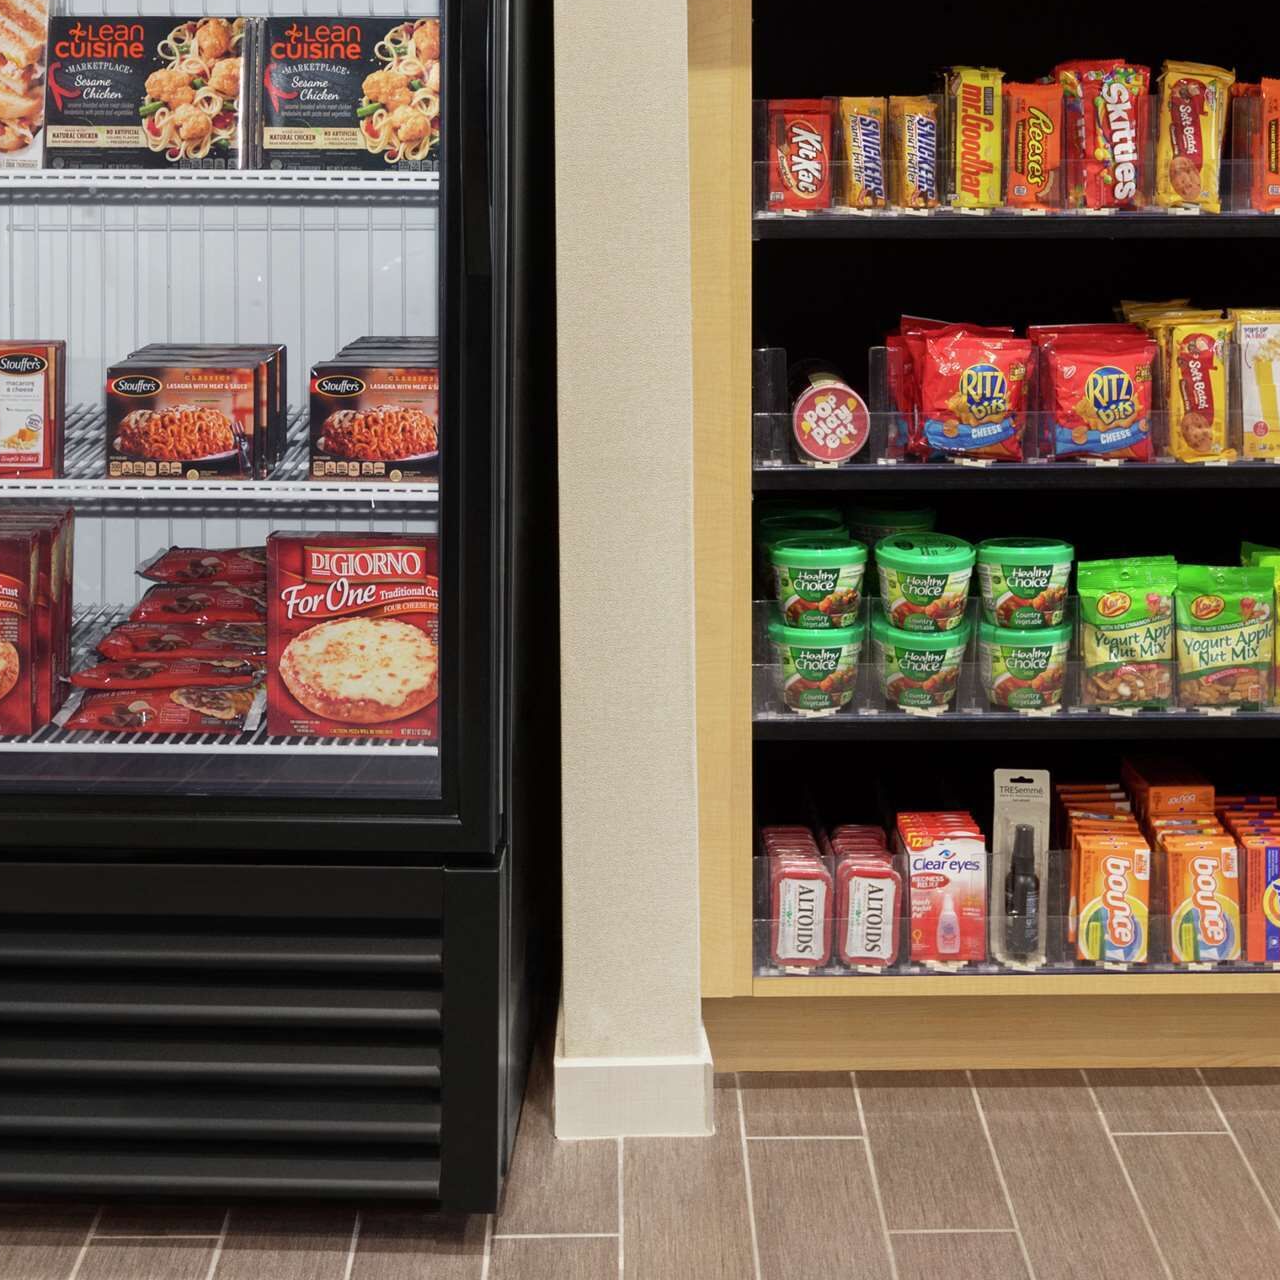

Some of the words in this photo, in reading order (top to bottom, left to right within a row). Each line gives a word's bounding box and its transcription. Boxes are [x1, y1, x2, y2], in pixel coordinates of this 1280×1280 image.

[88, 24, 144, 41] Lean
[304, 25, 360, 42] Lean
[69, 62, 130, 73] MARKETPLACE
[284, 63, 347, 74] MARKETPLACE
[74, 75, 111, 86] Sesame
[292, 76, 329, 87] Sesame
[83, 88, 122, 99] Chicken
[300, 89, 339, 101] Chicken
[1028, 107, 1054, 186] Reese's
[1103, 83, 1137, 200] Skittles
[859, 117, 886, 200] SNICKERS
[917, 114, 936, 199] SNICKERS
[0, 358, 40, 371] Stouffer's
[118, 380, 155, 392] Stouffer's
[321, 380, 360, 393] Stouffer's
[962, 369, 1005, 400] RITZ
[1088, 374, 1131, 406] RITZ
[970, 398, 1006, 420] bits
[1096, 401, 1135, 424] bits
[971, 424, 1002, 438] CHEESE
[1100, 429, 1131, 444] CHEESE
[798, 571, 837, 581] Healthy
[1012, 567, 1050, 577] Healthy
[793, 579, 834, 591] Choice
[906, 576, 946, 586] Healthy
[1007, 576, 1048, 588] Choice
[380, 587, 424, 600] Traditional
[901, 584, 942, 595] Choice
[281, 583, 324, 619] For
[326, 578, 376, 610] One
[0, 601, 18, 610] PIZZA
[384, 604, 401, 612] FOUR
[402, 602, 428, 610] CHEESE
[1094, 632, 1139, 647] Yogurt
[1144, 624, 1170, 643] App
[1109, 645, 1135, 660] Nut
[1140, 643, 1165, 656] Mix
[1184, 636, 1232, 655] Yogurt
[800, 650, 839, 660] Healthy
[904, 652, 944, 662] Healthy
[1011, 650, 1050, 659] Healthy
[1199, 652, 1226, 667] Nut
[1231, 646, 1258, 660] Mix
[794, 658, 836, 670] Choice
[898, 659, 939, 671] Choice
[1006, 657, 1047, 669] Choice
[913, 858, 947, 870] Clear
[949, 861, 979, 873] eyes
[797, 885, 815, 954] ALTOIDS
[865, 884, 884, 952] ALTOIDS
